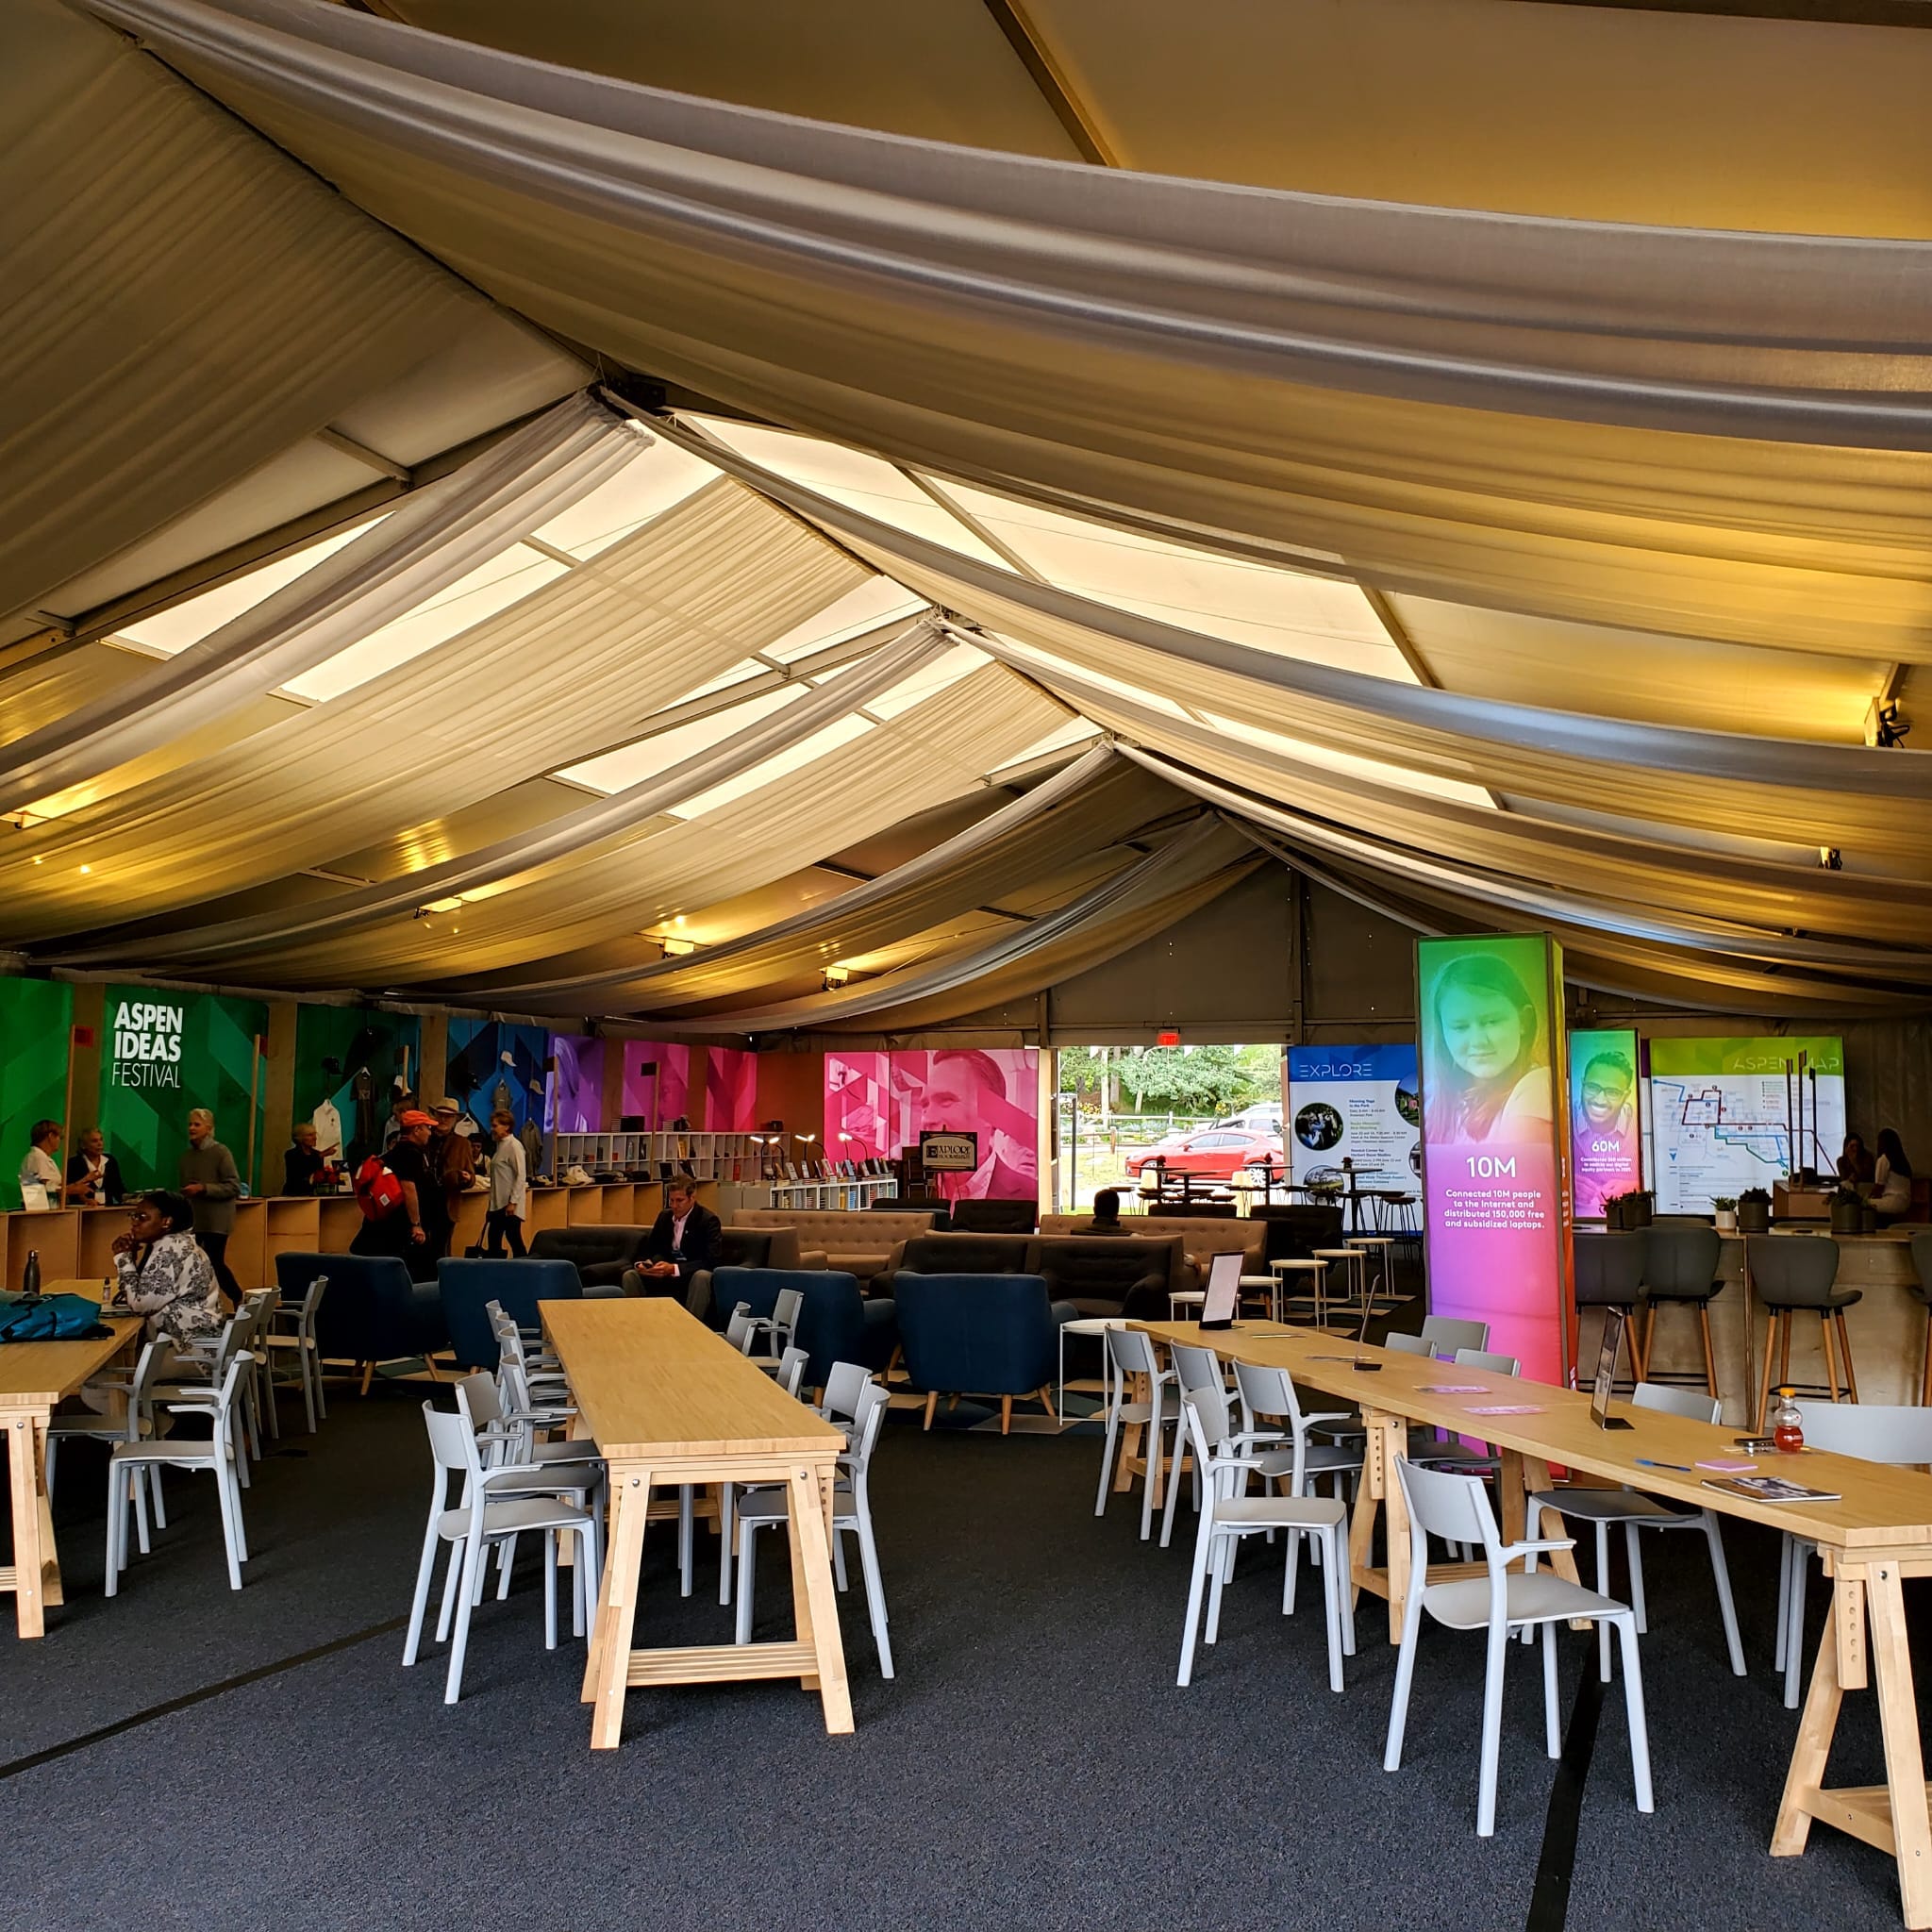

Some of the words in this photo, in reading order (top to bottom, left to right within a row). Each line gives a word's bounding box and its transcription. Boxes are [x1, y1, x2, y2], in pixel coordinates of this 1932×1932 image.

[113, 1002, 183, 1033] ASPEN
[114, 1031, 181, 1062] IDEAS
[112, 1062, 181, 1088] FESTIVAL
[1299, 1064, 1373, 1077] EXPLORE
[1591, 1141, 1620, 1152] 60M
[1466, 1157, 1516, 1178] 10M
[1445, 1189, 1491, 1197] Connected
[1512, 1191, 1541, 1199] people
[1444, 1209, 1491, 1218] distributed
[1492, 1210, 1525, 1219] 150,000
[1463, 1220, 1507, 1228] subsidized
[1509, 1221, 1545, 1230] laptops.
